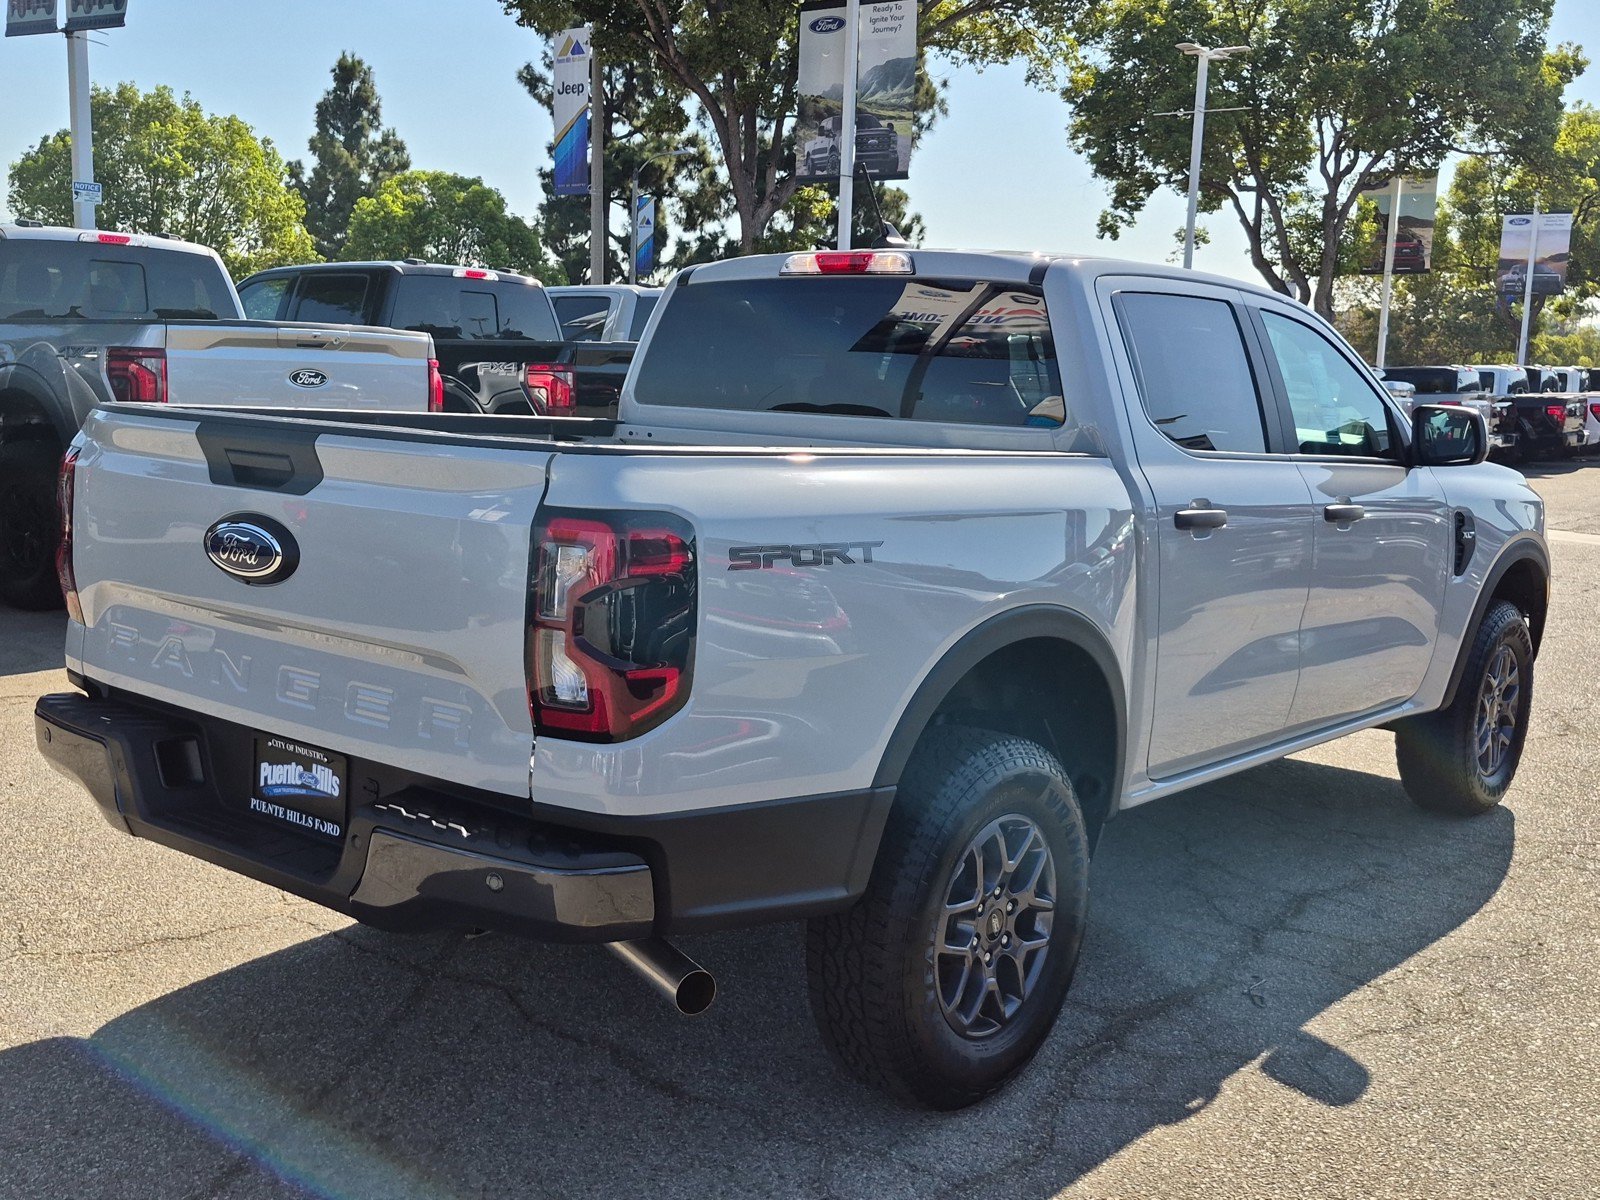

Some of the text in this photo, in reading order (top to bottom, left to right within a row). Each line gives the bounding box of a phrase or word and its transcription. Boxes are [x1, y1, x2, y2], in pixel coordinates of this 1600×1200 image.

[872, 3, 903, 13] Ready To
[815, 18, 840, 31] Ford
[869, 14, 905, 25] Ignite Your
[871, 24, 902, 34] Journey?
[557, 81, 585, 96] Jeep
[74, 182, 100, 192] NOTICE
[477, 361, 518, 376] FX4
[296, 371, 322, 385] Ford
[219, 532, 260, 566] Ford
[727, 540, 885, 571] SPORT
[108, 621, 473, 749] RANGER
[271, 738, 325, 761] CITY OF INDUSTRY
[260, 761, 340, 797] Puente Hills
[250, 797, 340, 837] PUENTE HILLS FORD
